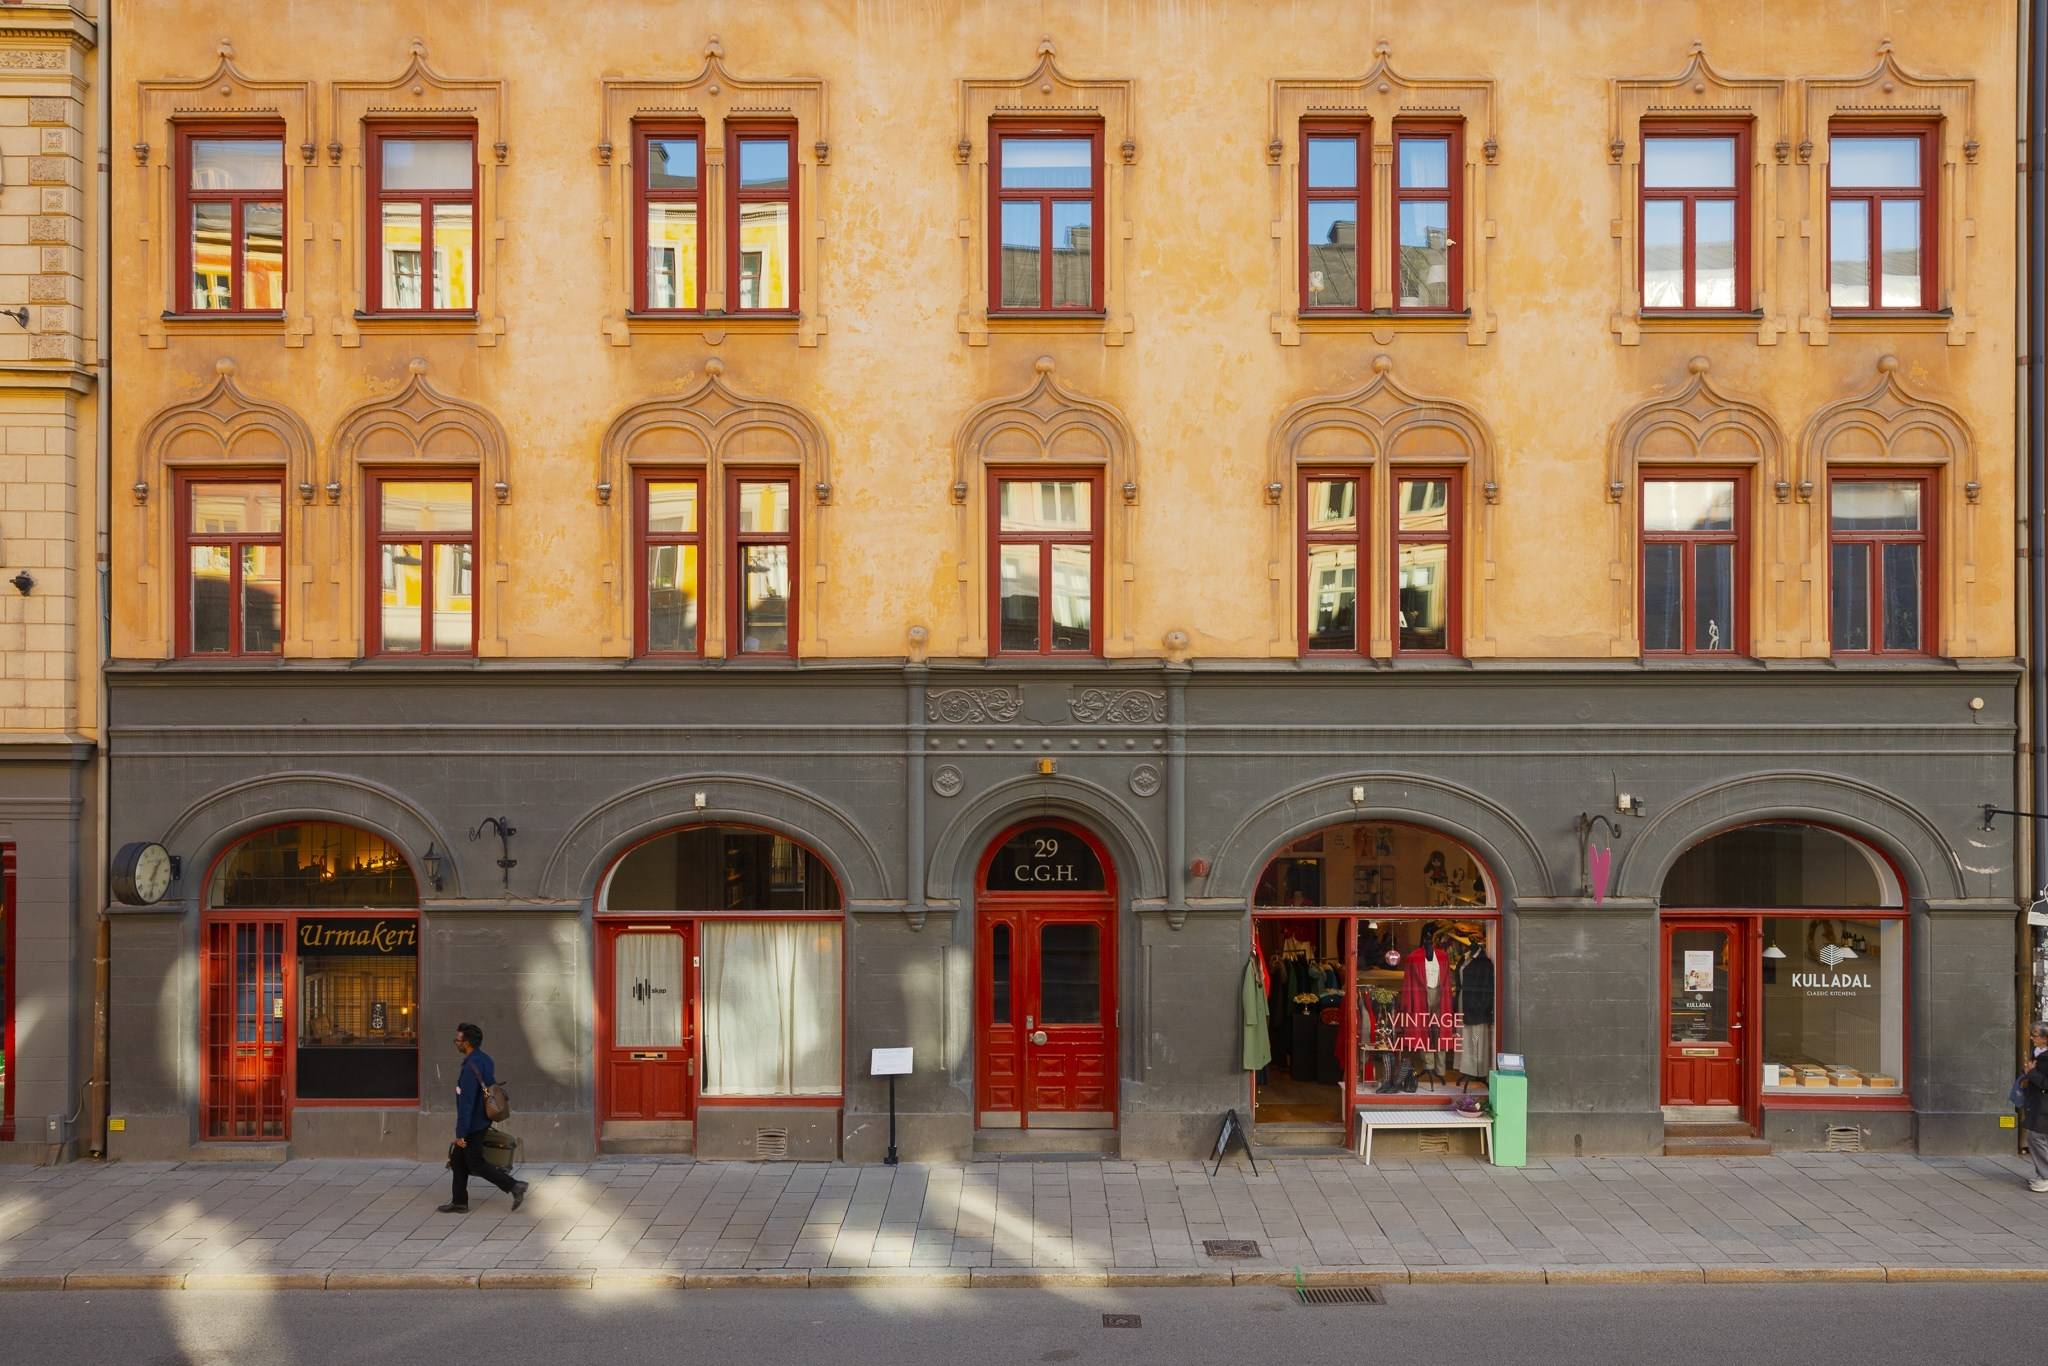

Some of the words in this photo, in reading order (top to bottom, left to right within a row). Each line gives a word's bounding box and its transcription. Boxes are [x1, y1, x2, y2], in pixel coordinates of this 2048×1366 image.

[1034, 839, 1058, 858] 29
[1015, 864, 1078, 882] C.G.H.
[300, 921, 416, 952] Urmakeri
[1791, 973, 1872, 988] KULLADAL
[1387, 1012, 1465, 1028] VINTAGE
